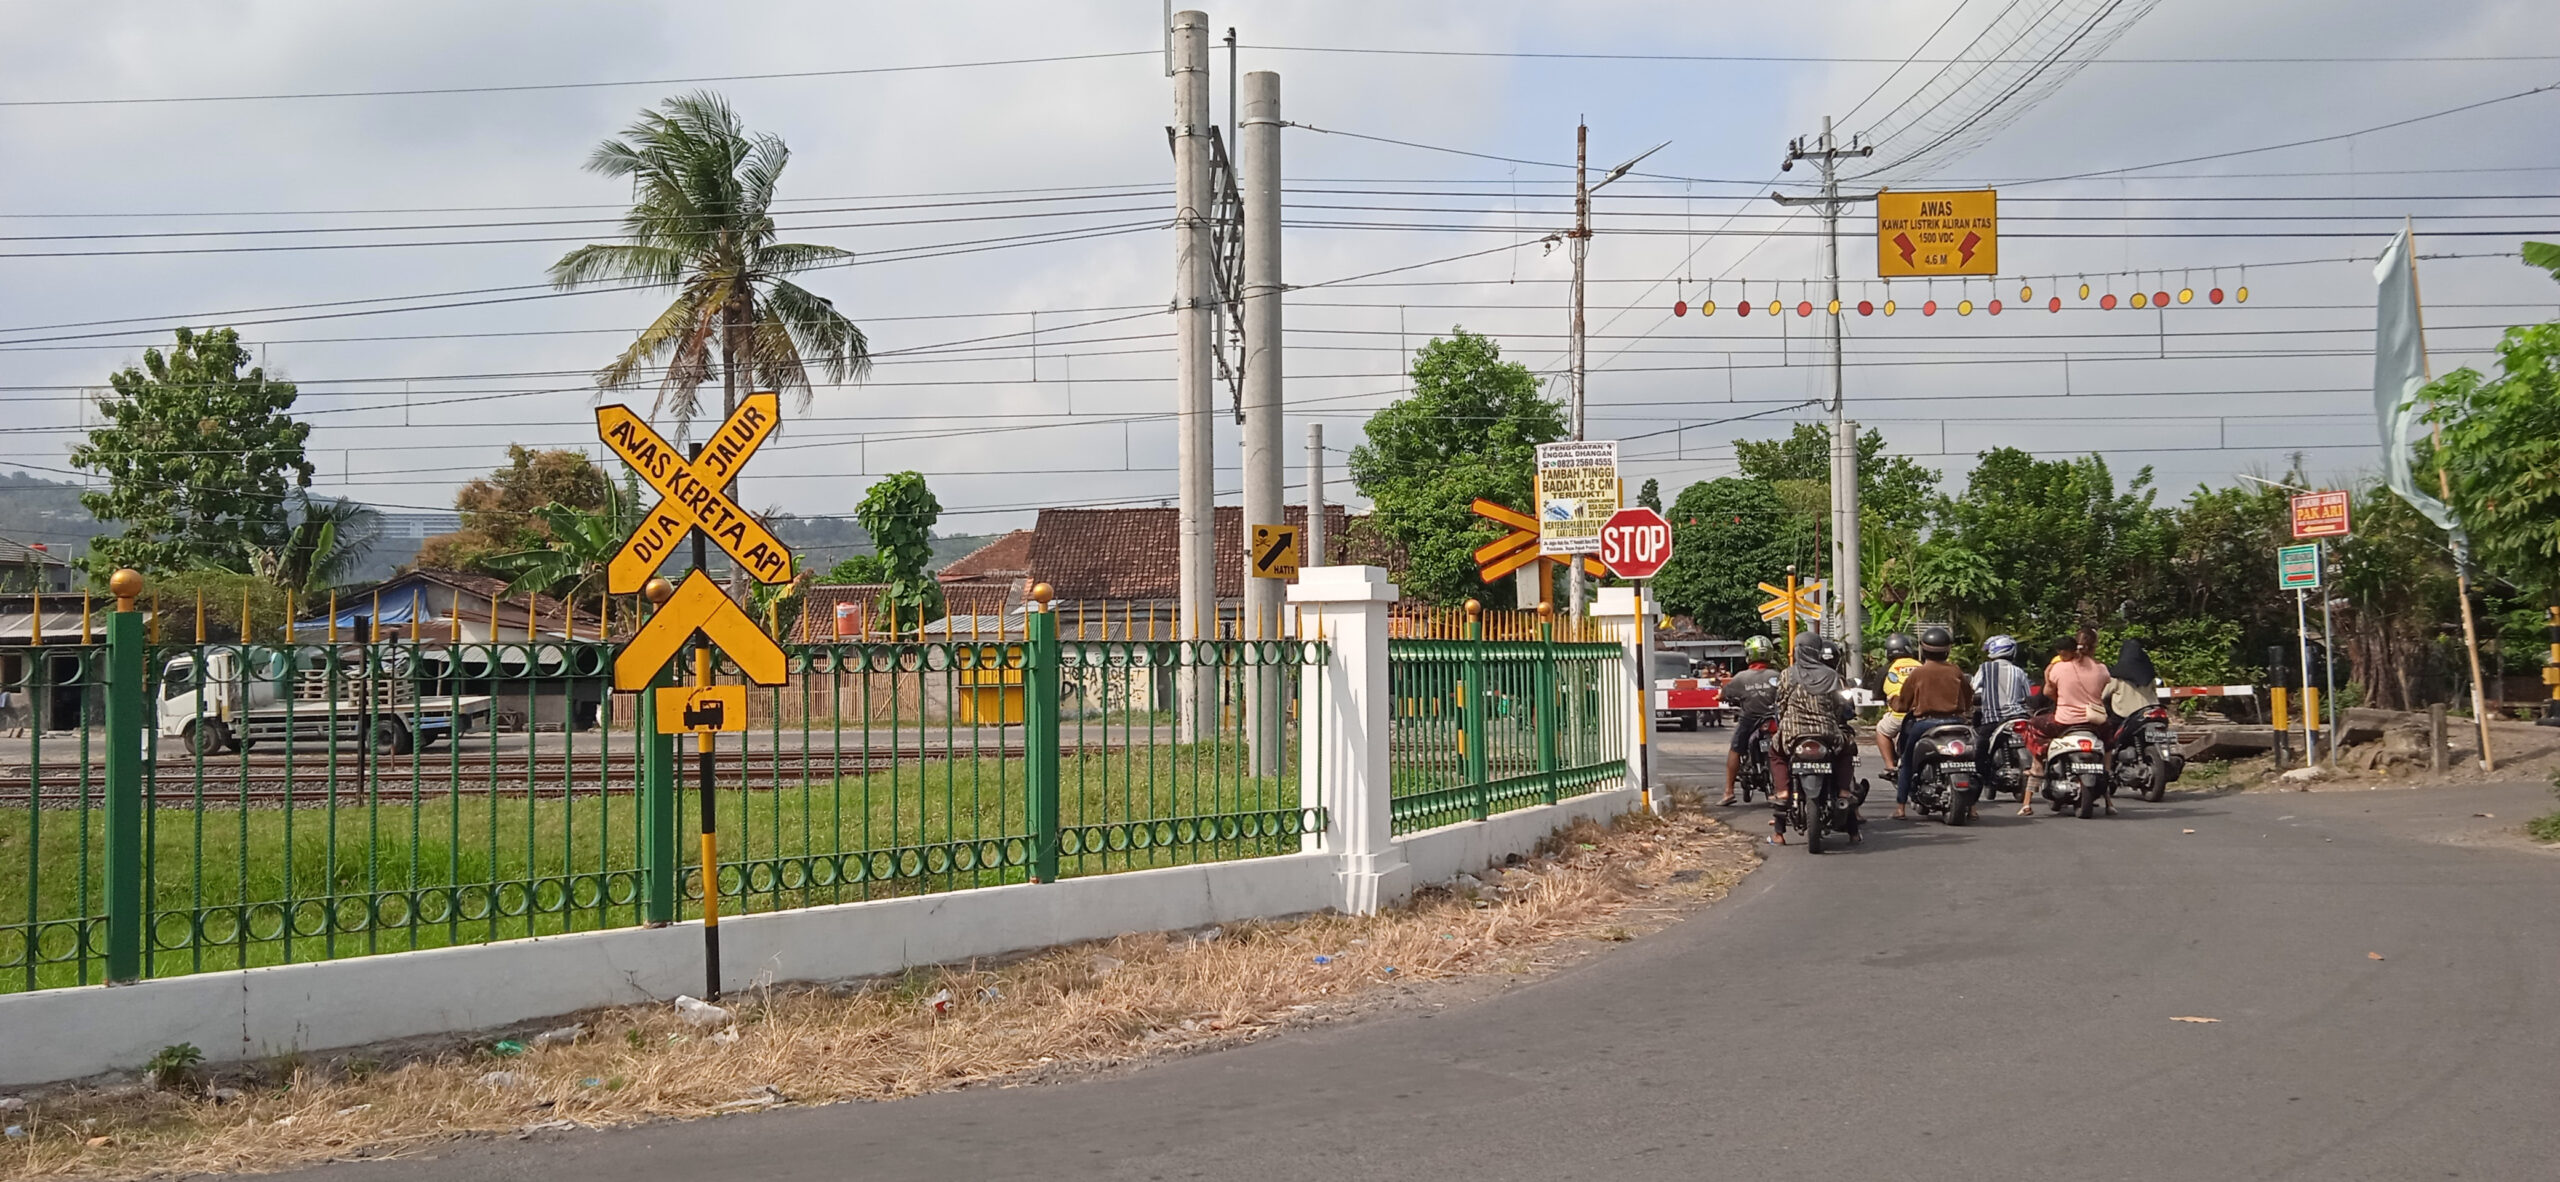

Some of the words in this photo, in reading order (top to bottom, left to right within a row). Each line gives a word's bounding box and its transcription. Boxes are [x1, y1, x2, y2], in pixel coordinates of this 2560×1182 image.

[1920, 200, 1952, 217] AWAS
[1881, 219, 1908, 230] KAWAT
[1910, 219, 1940, 230] LISTRIK
[1942, 218, 1970, 229] ALIRAN
[1972, 218, 1992, 229] ATAS
[1919, 232, 1937, 243] 1500
[1938, 232, 1954, 243] VDC
[1924, 254, 1938, 265] 4.6
[1940, 254, 1948, 265] M
[1541, 468, 1580, 480] TAMBAH
[1582, 467, 1615, 478] TINGGI
[633, 514, 680, 564] DUA
[704, 406, 767, 478] JALUR
[1542, 480, 1577, 492] BADAN
[1580, 479, 1595, 491] 1-6
[1598, 478, 1614, 490] CM
[609, 420, 672, 479] AWAS
[665, 466, 747, 551] KERETA
[742, 542, 786, 582] API
[1551, 491, 1605, 499] TERBUKTI
[2296, 507, 2320, 521] PAK
[2322, 504, 2343, 518] ARI
[1604, 525, 1666, 564] STOP
